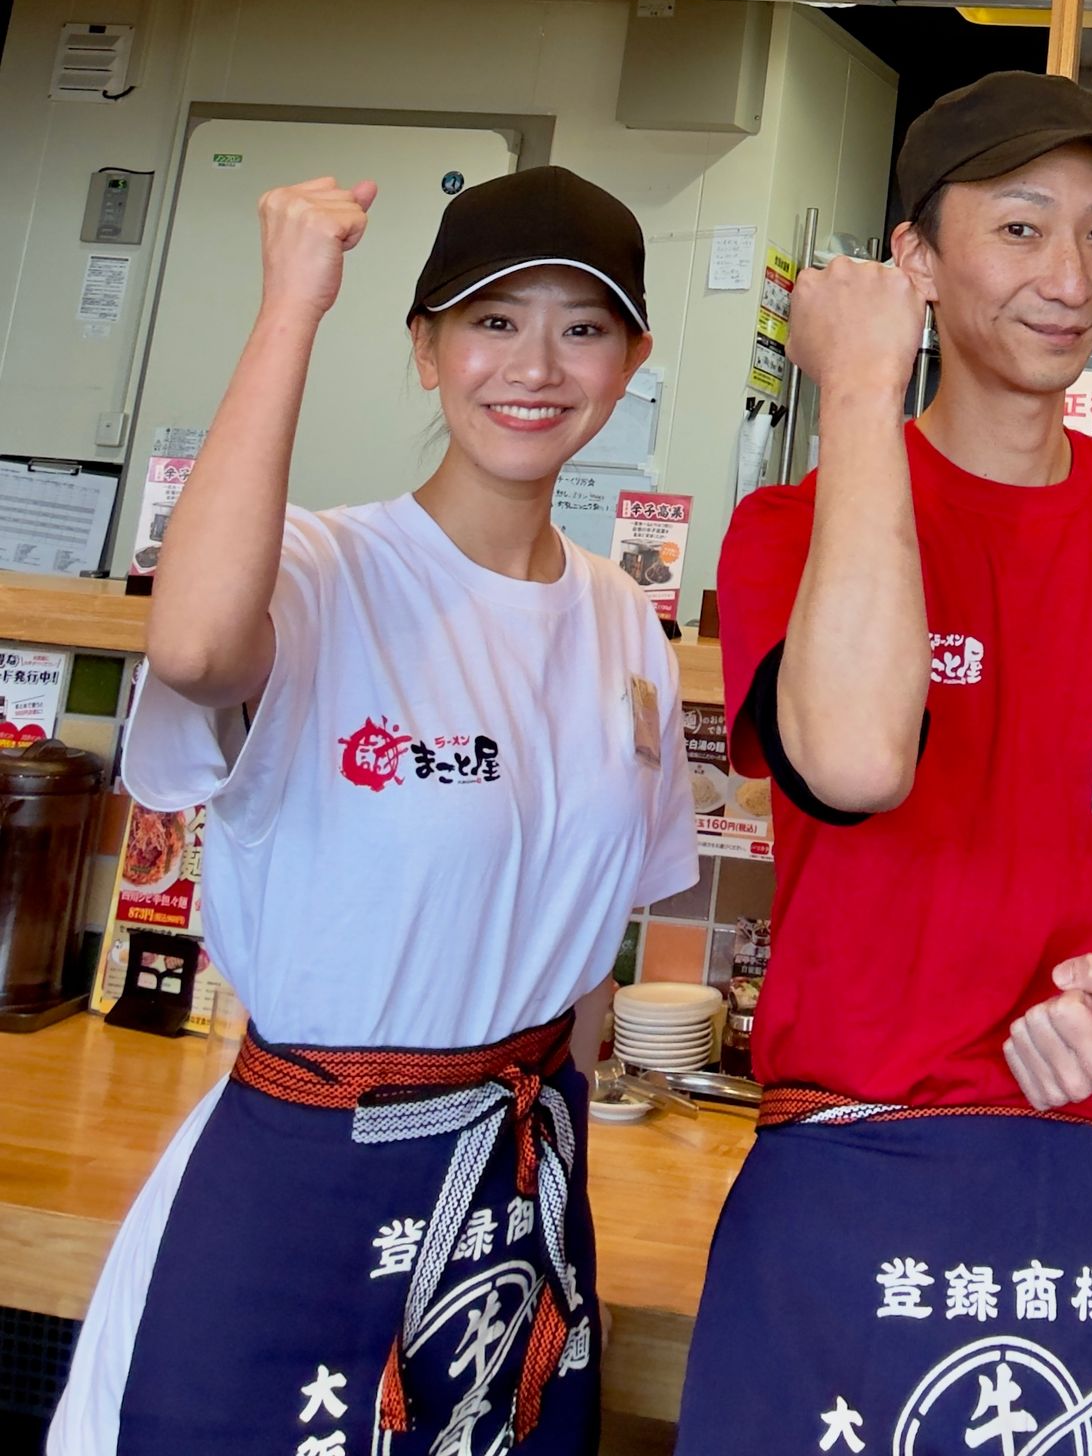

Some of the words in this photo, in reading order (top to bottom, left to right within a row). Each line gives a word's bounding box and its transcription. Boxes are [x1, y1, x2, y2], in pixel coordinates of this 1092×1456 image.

[630, 501, 685, 520] 辛子高菜
[434, 735, 471, 749] ラーメン
[410, 735, 501, 784] まこと屋
[696, 819, 757, 833] 玉160円(税込)
[819, 1396, 866, 1453] 大
